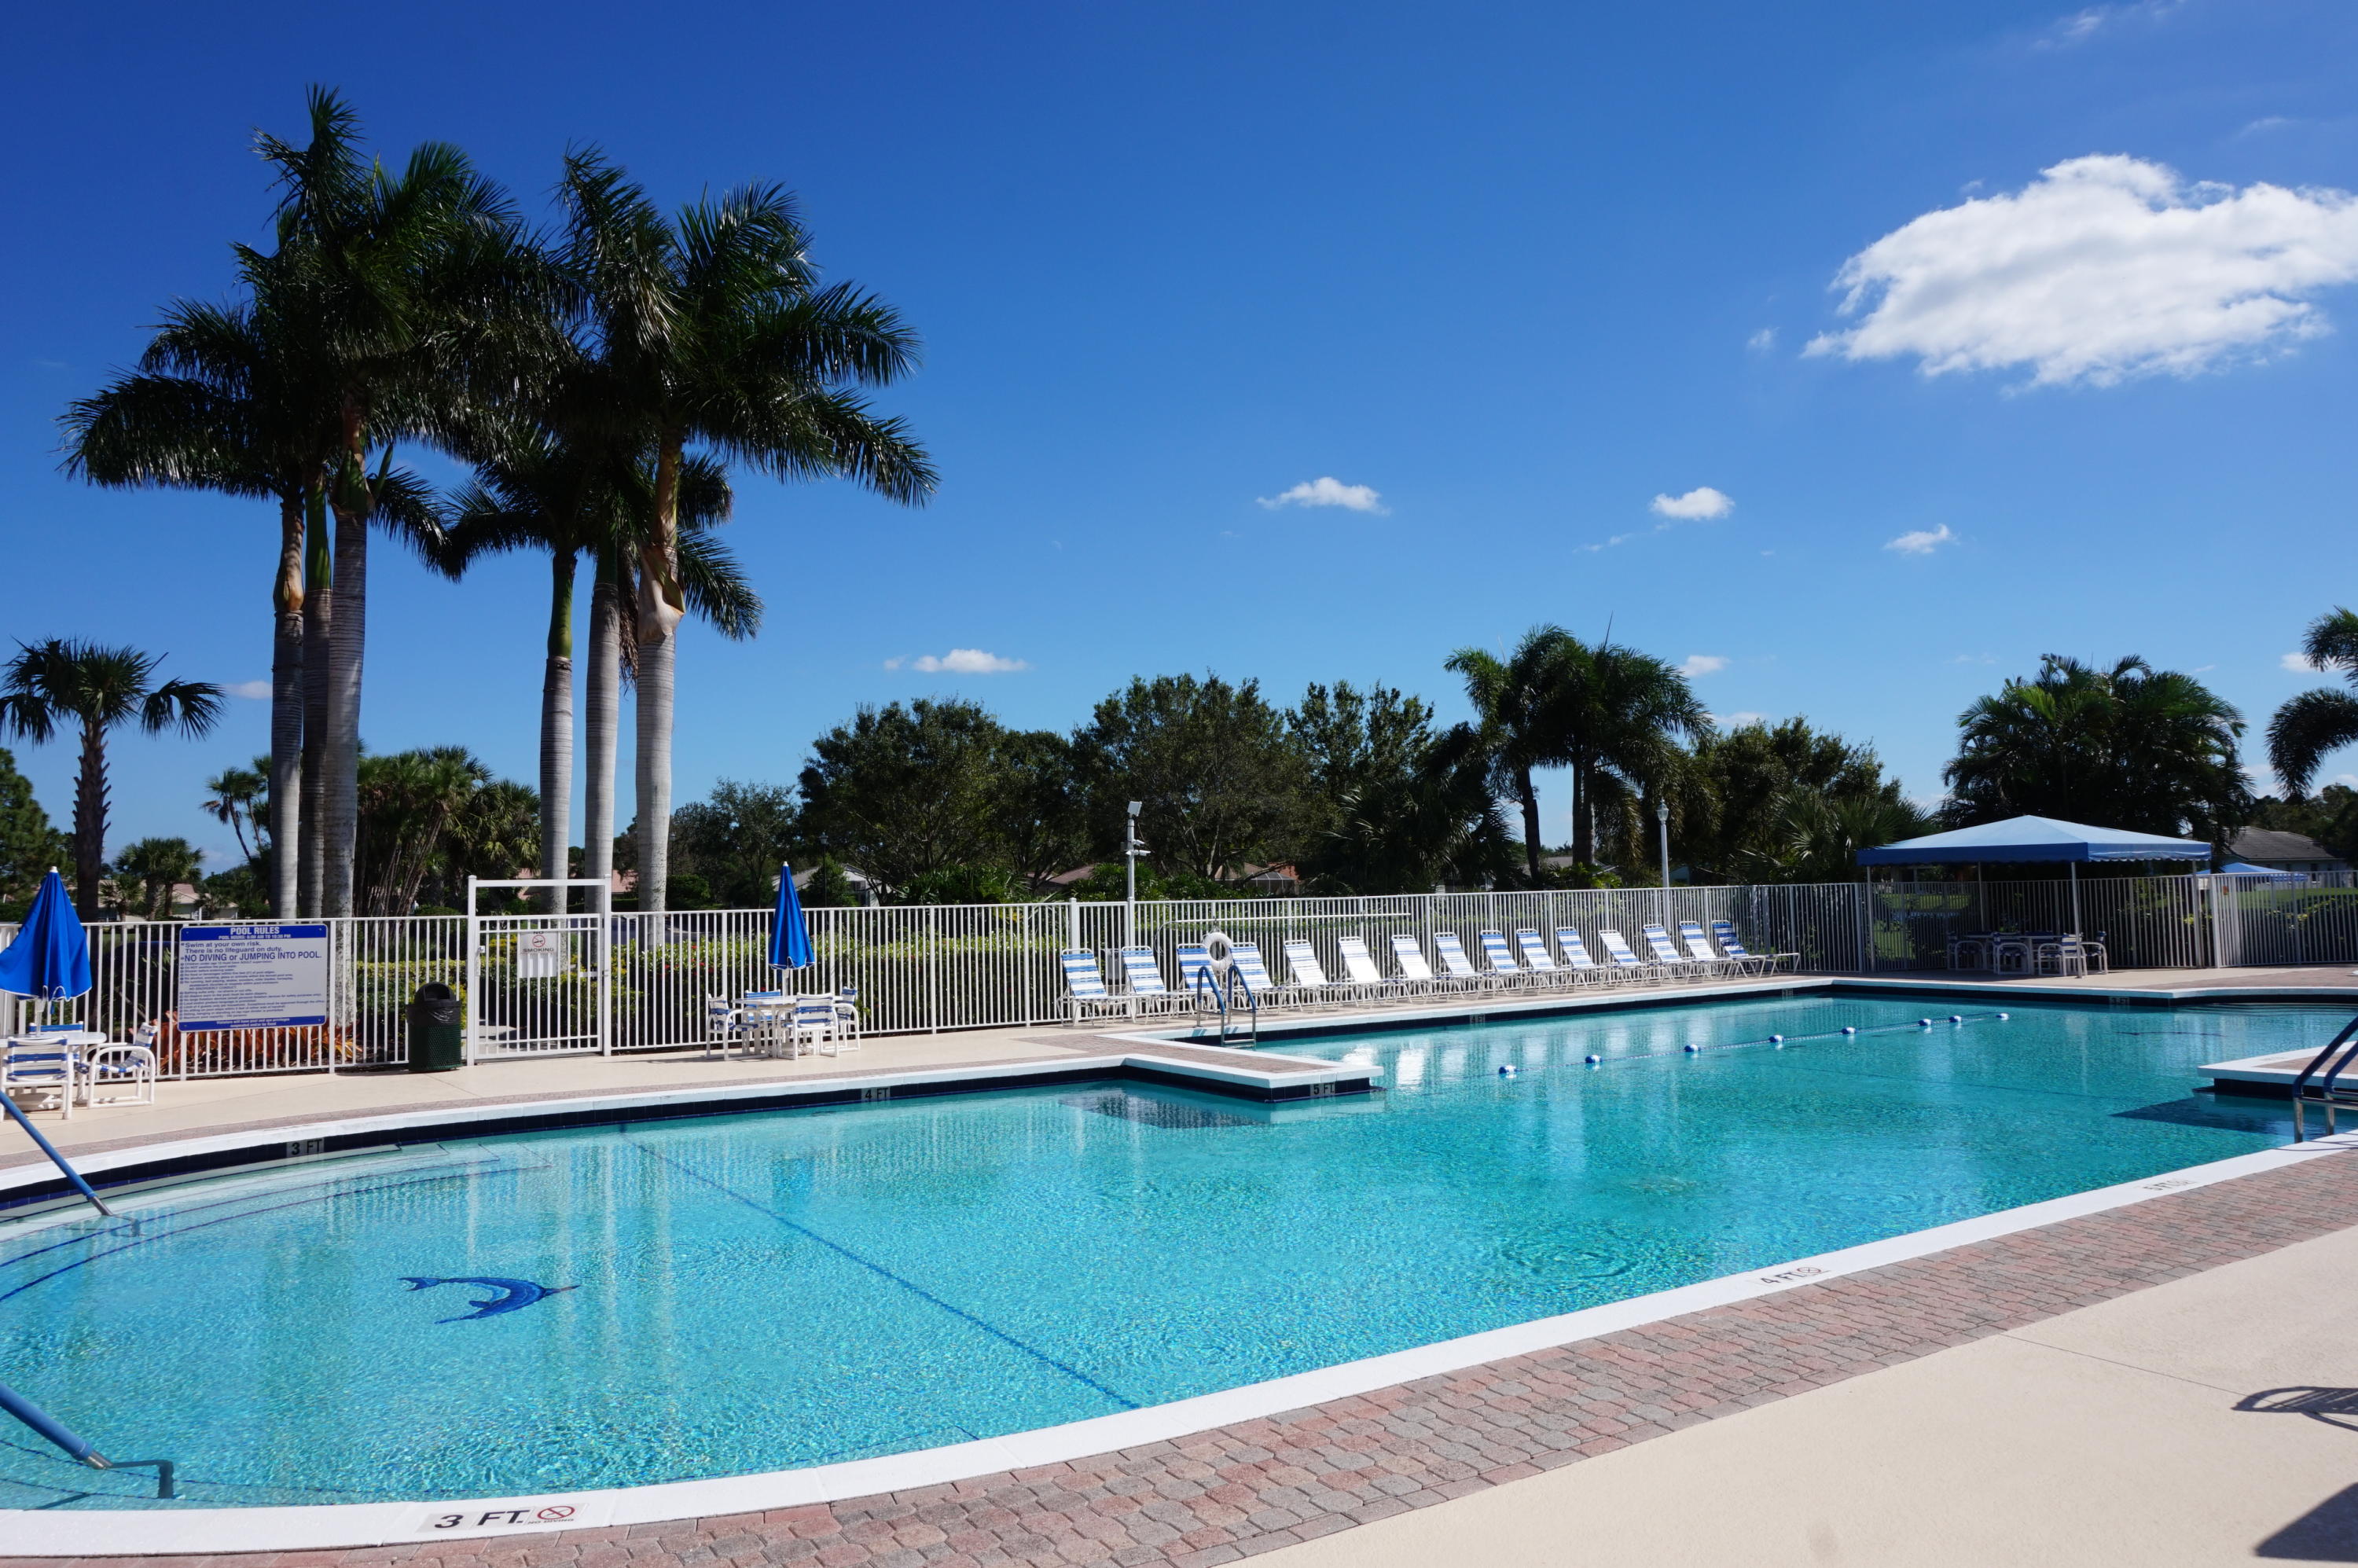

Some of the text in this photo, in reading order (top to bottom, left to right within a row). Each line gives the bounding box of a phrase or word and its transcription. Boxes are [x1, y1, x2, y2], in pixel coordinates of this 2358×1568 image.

[239, 952, 276, 960] JUMPING
[298, 950, 322, 959] POOL.
[865, 1088, 888, 1100] 4 FT
[1313, 1084, 1320, 1095] 5
[292, 1139, 322, 1155] 3 FT
[435, 1509, 531, 1529] 3 FT.
